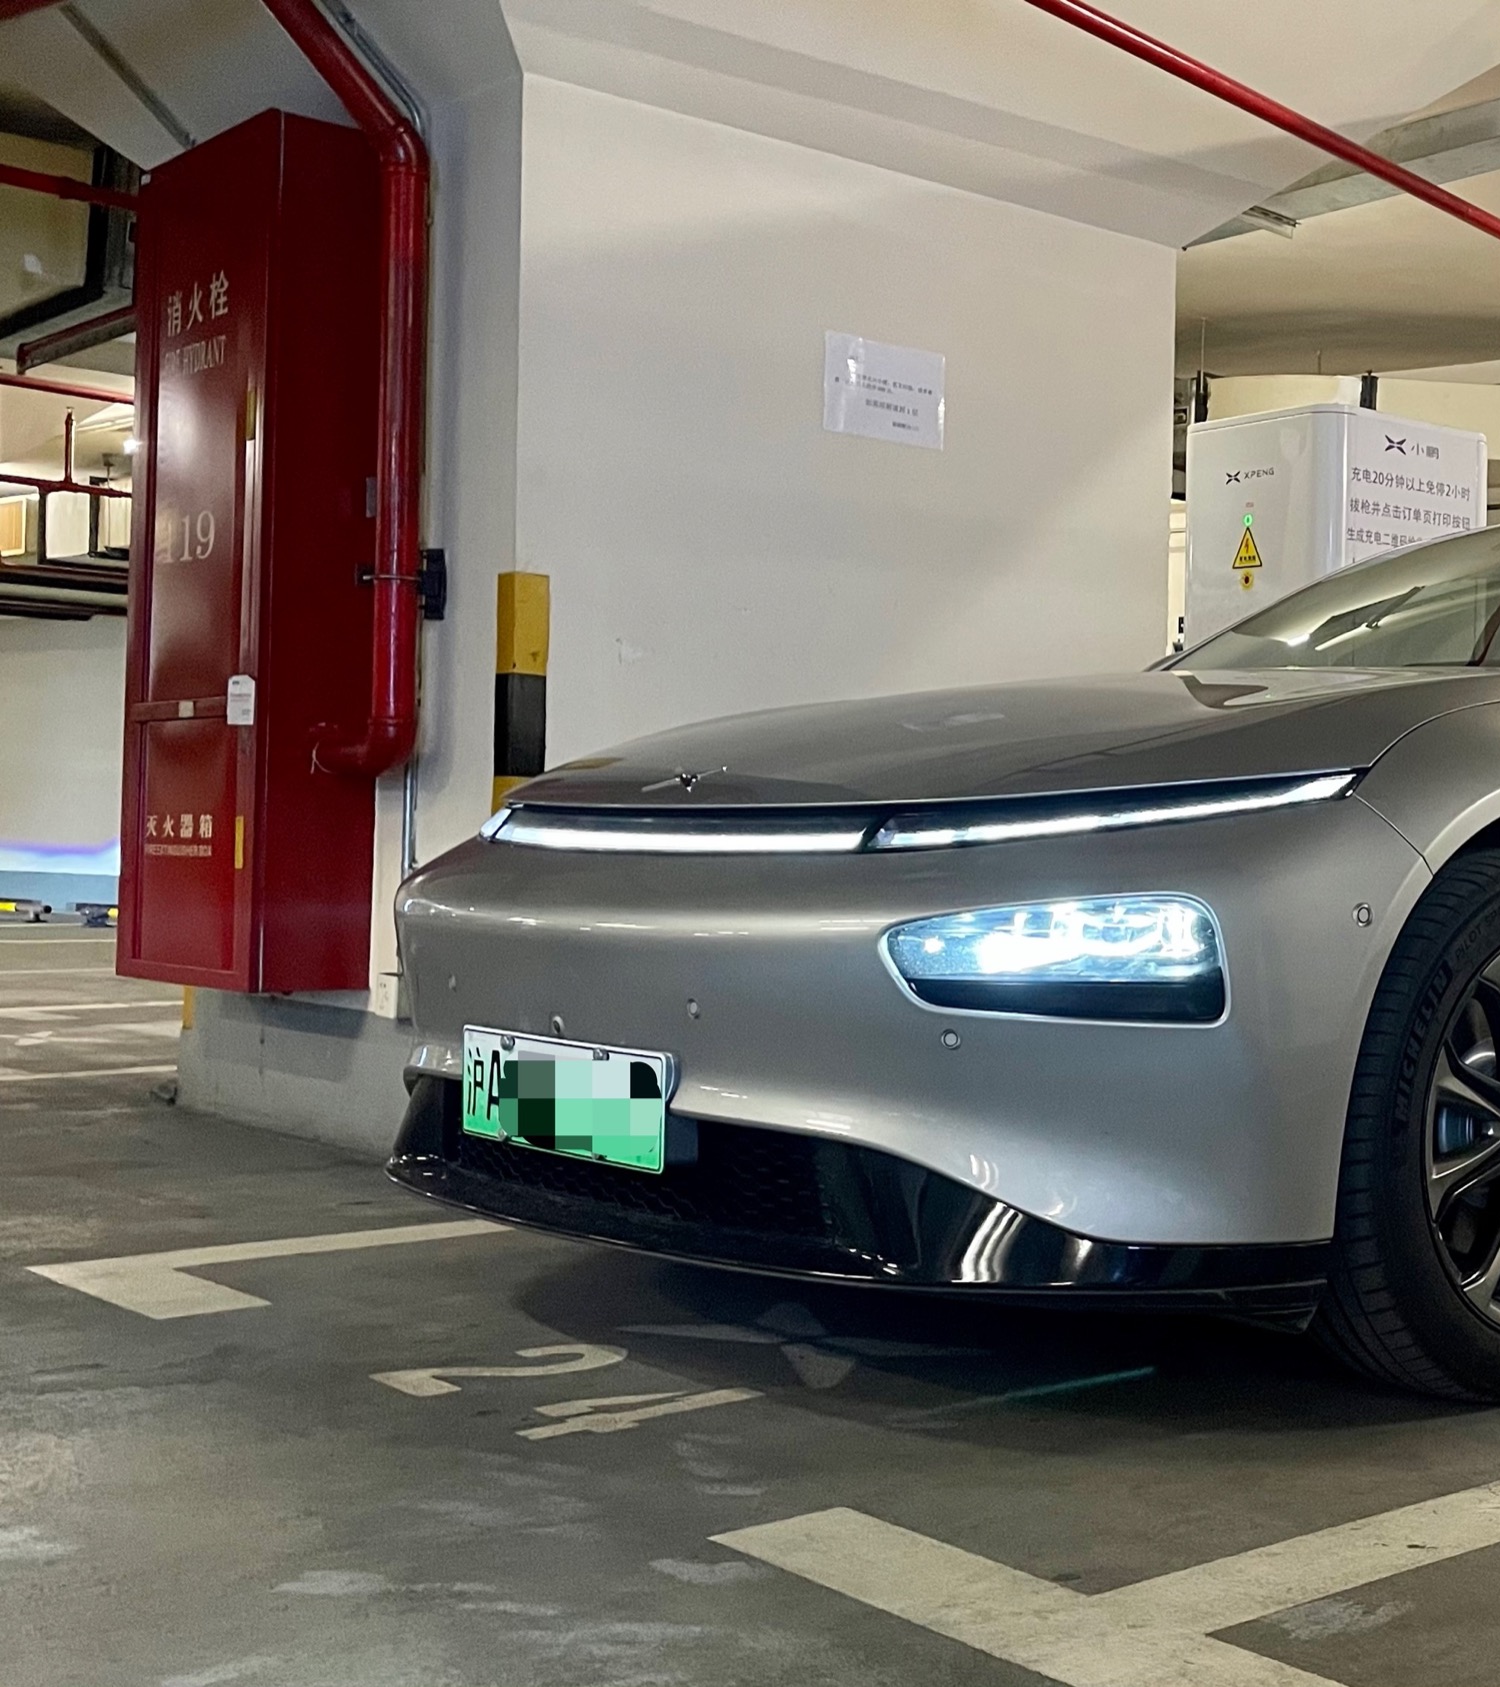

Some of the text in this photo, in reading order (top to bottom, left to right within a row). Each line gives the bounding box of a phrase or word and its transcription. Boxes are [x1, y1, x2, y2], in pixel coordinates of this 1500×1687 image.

[167, 270, 229, 337] 消火栓
[1244, 467, 1275, 480] XPENG
[1351, 466, 1471, 501] 充电20分钟以上免停2小时
[1350, 497, 1471, 531] 拔枪并点击订单页打印按钮
[145, 813, 213, 838] 灭火器箱
